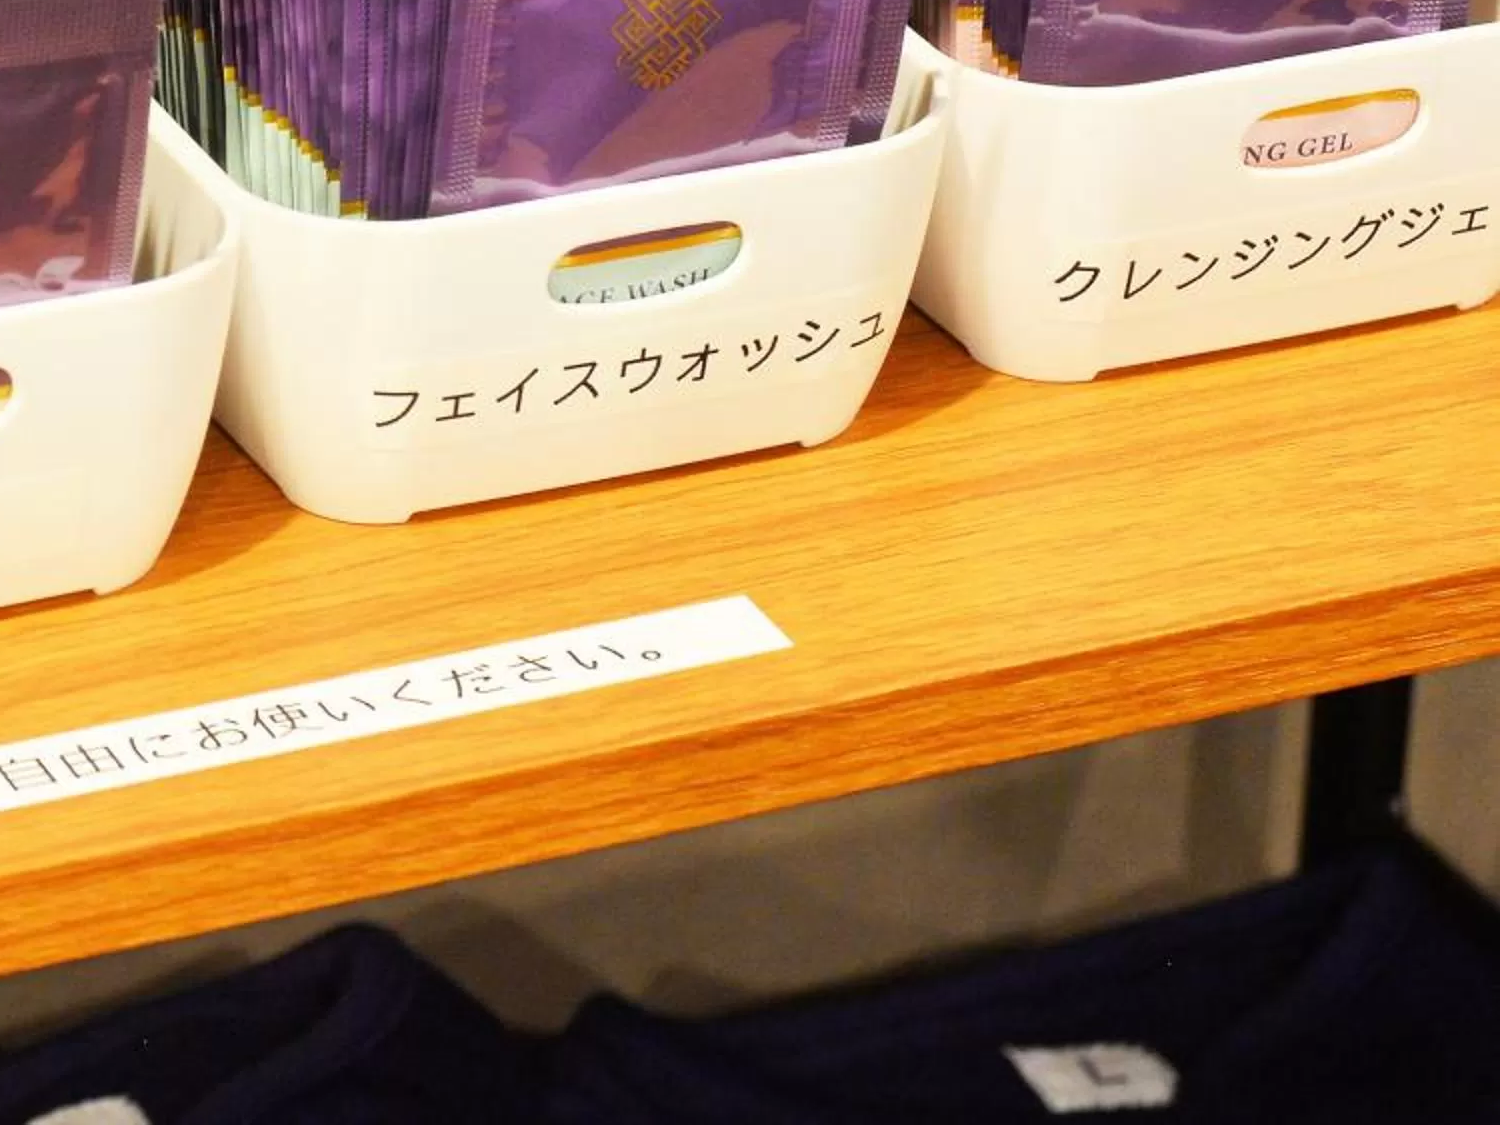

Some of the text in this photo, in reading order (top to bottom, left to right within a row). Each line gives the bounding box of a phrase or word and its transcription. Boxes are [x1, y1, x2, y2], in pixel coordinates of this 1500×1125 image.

[1297, 132, 1352, 158] GEL
[1053, 202, 1489, 303] クレンジングジェ
[373, 311, 886, 428] フェイスウォッシュ
